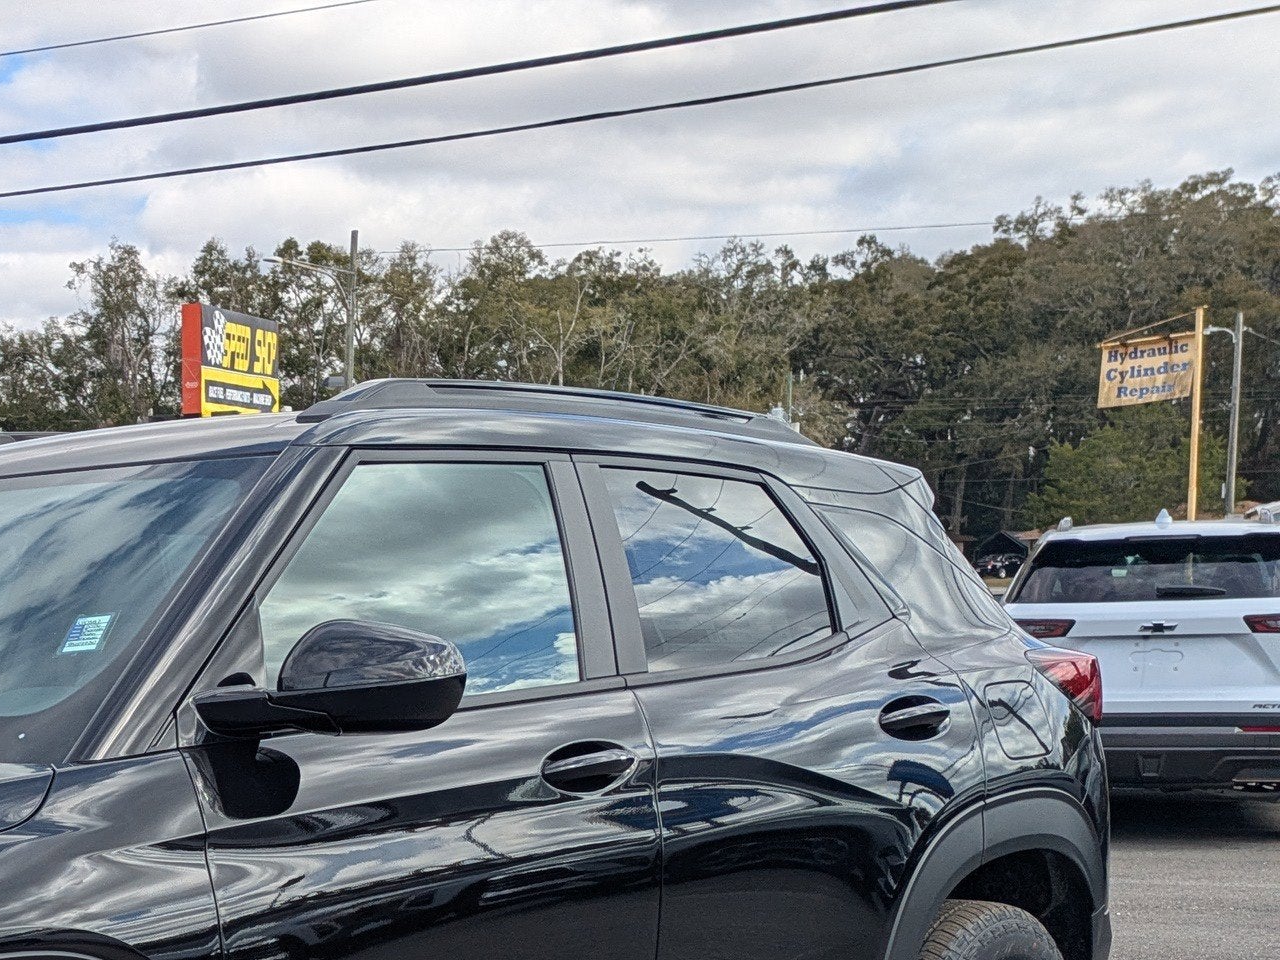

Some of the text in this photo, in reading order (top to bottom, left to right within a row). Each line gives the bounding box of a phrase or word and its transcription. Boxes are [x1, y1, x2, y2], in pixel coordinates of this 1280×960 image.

[222, 322, 277, 374] SPEED SHOP
[1107, 341, 1189, 365] Hydraulic
[1105, 360, 1191, 384] Cylinder
[1116, 383, 1175, 399] Repair
